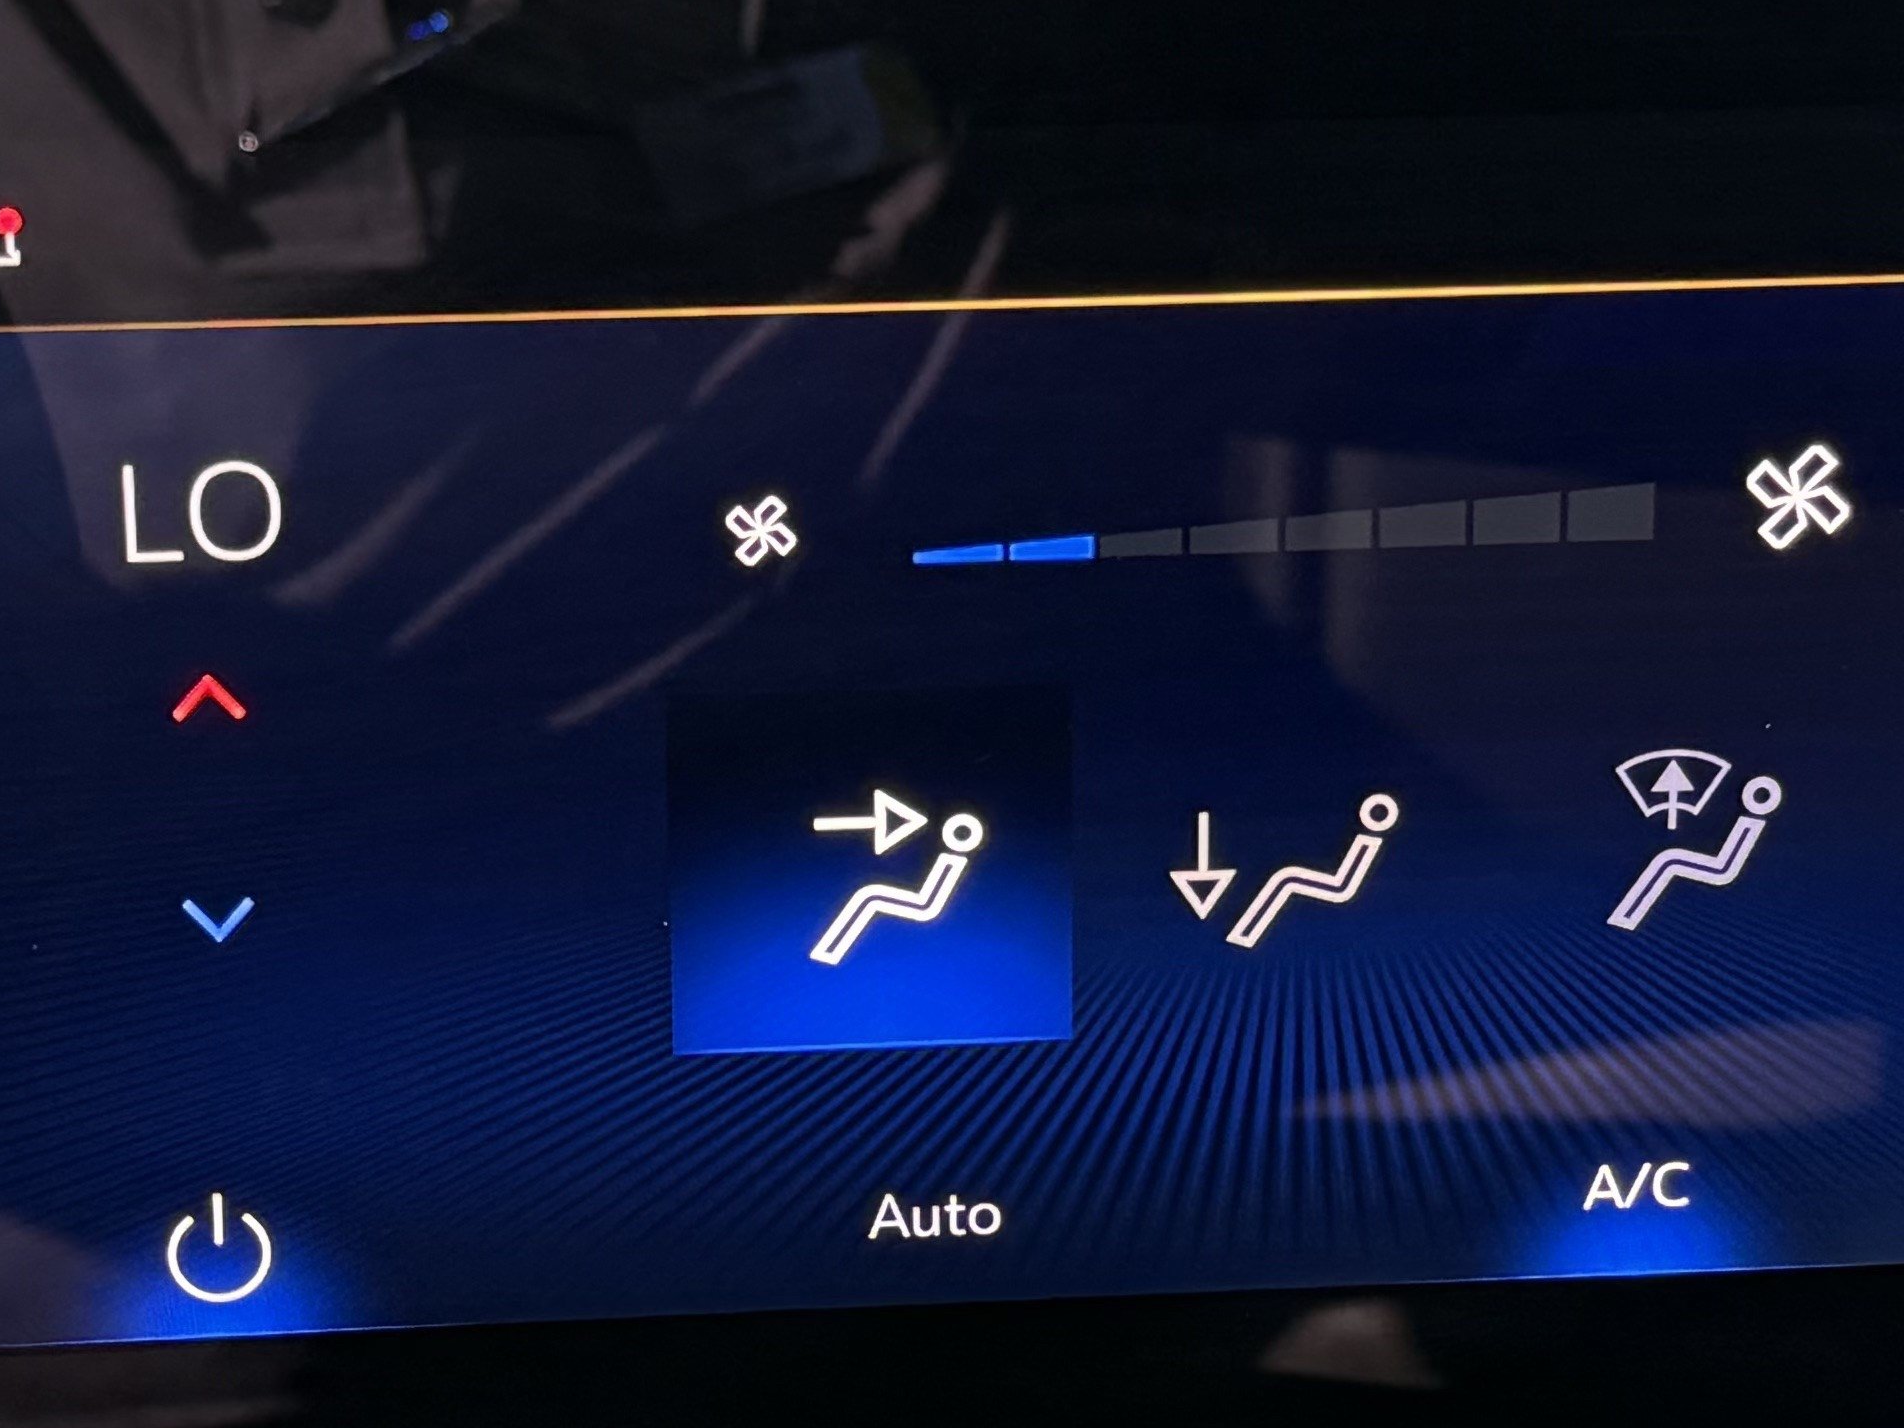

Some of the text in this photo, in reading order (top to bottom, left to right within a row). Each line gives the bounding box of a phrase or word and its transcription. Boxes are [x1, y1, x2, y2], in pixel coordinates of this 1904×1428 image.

[120, 458, 283, 565] LO
[1581, 1160, 1692, 1212] A/C
[866, 1192, 1003, 1241] Auto
